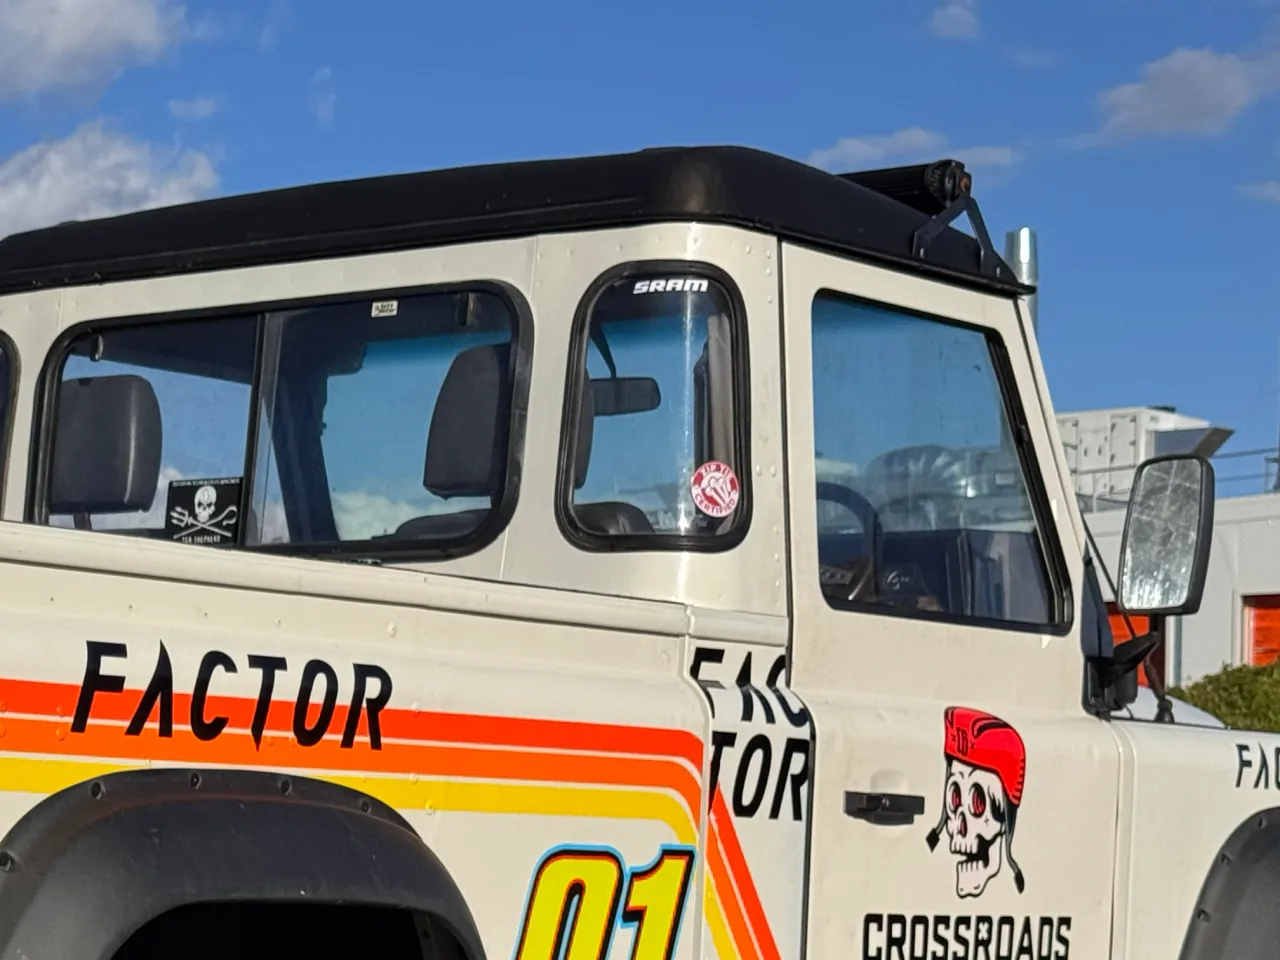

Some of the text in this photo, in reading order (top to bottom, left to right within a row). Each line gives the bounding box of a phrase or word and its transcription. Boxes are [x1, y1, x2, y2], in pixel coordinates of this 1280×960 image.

[632, 279, 709, 295] SRAM
[70, 638, 394, 752] FACTOR
[707, 730, 810, 822] TOR
